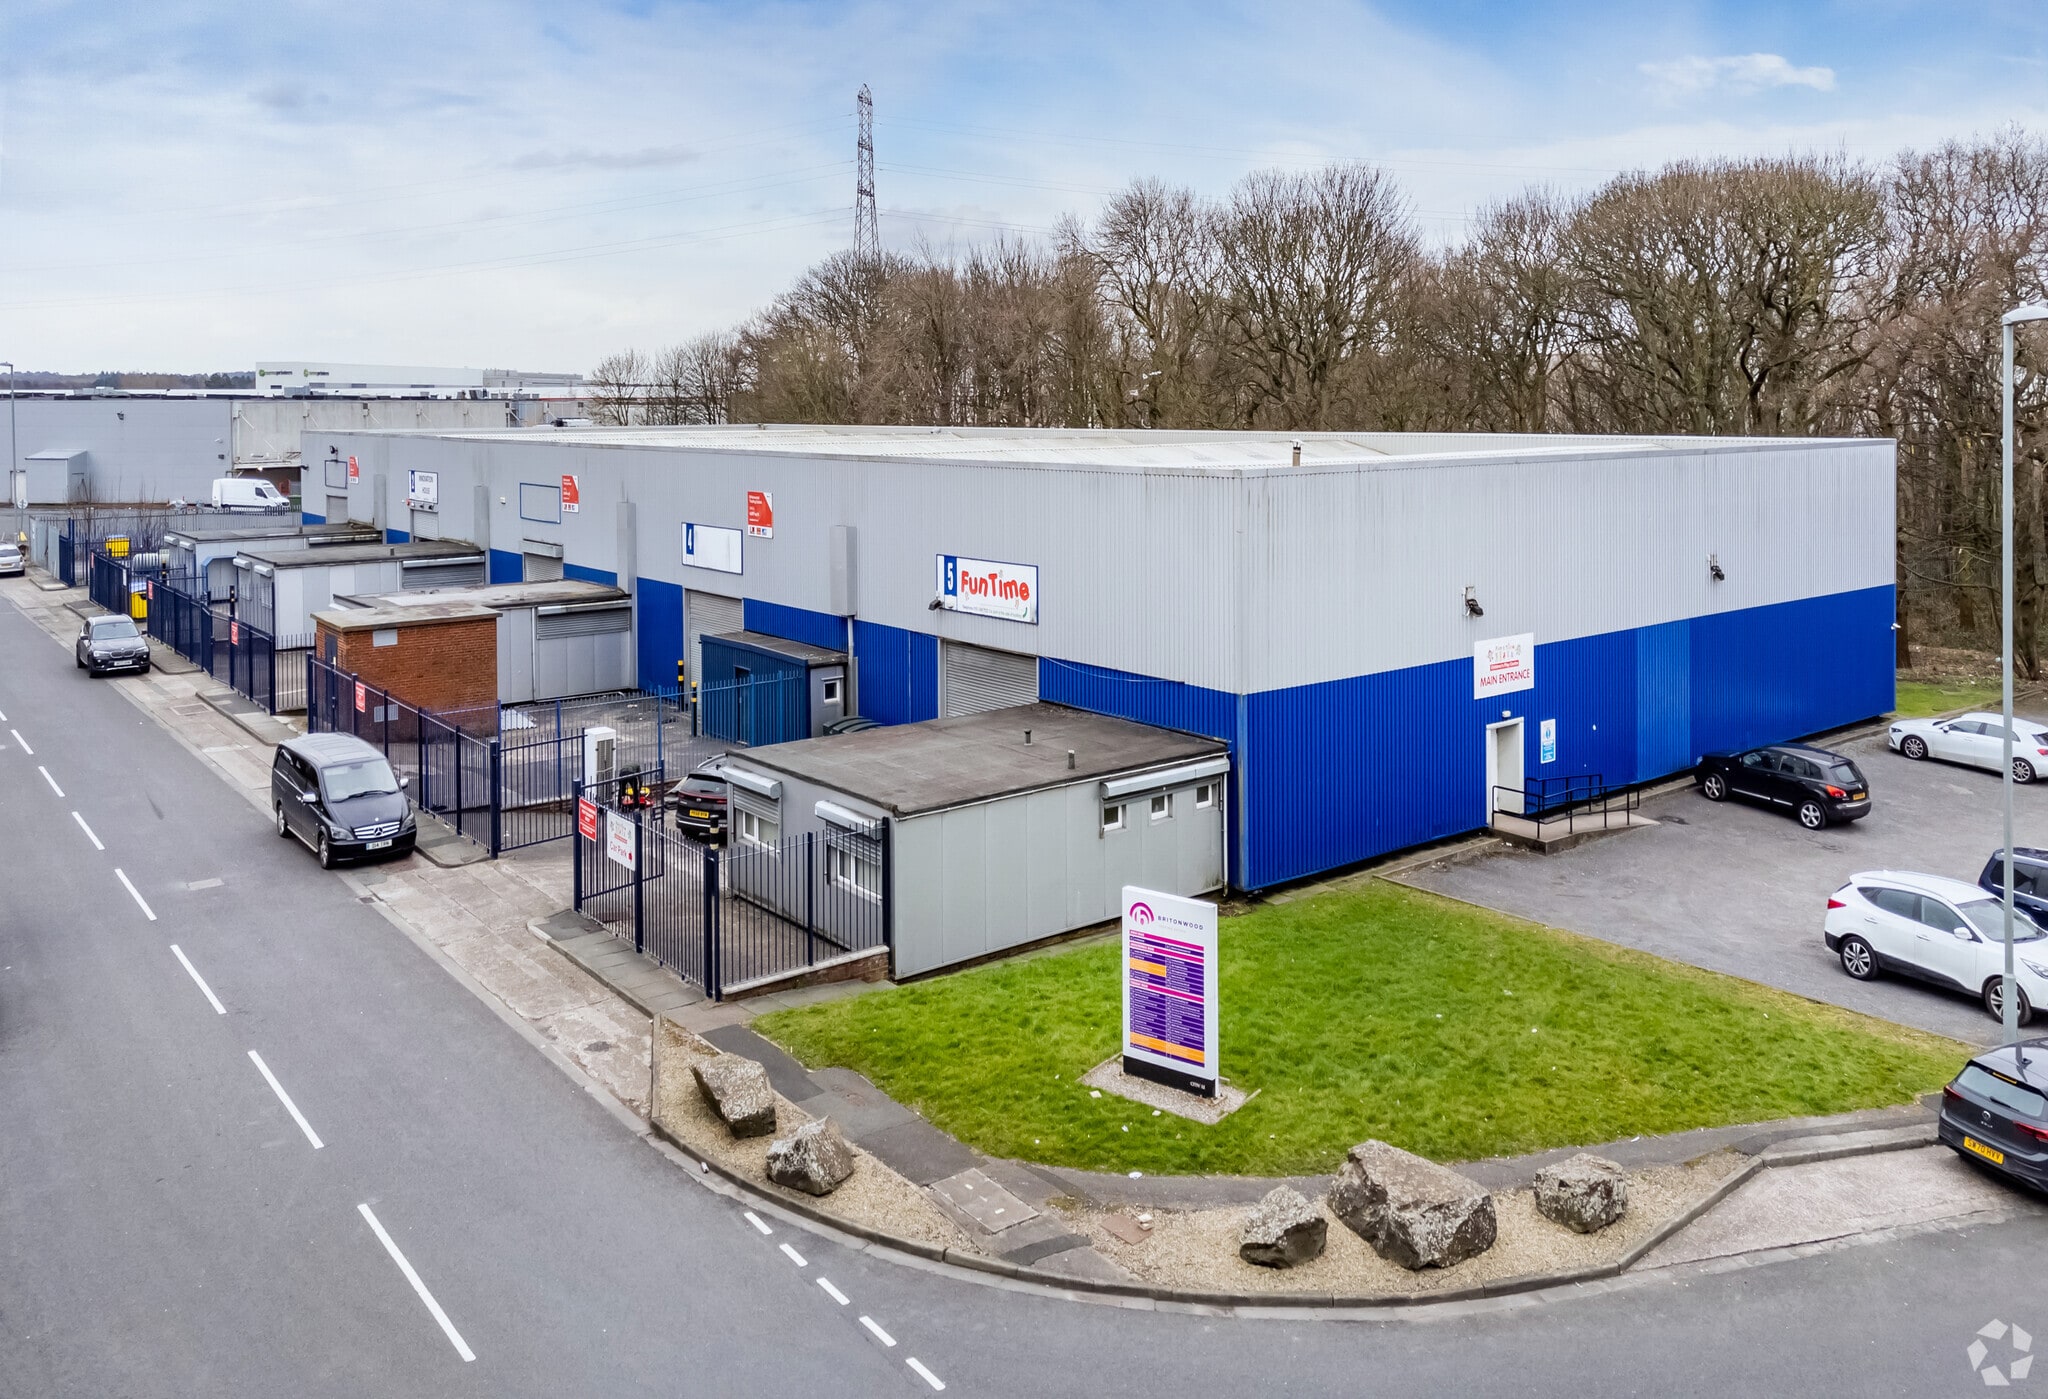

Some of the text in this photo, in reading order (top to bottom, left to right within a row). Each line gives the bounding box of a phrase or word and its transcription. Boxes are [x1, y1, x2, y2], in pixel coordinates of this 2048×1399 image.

[687, 528, 693, 550] 4
[947, 562, 954, 591] 5
[961, 570, 1030, 601] FunTime
[1480, 668, 1530, 687] MAIN ENTRANCE
[1157, 915, 1204, 931] BRITONWOOD
